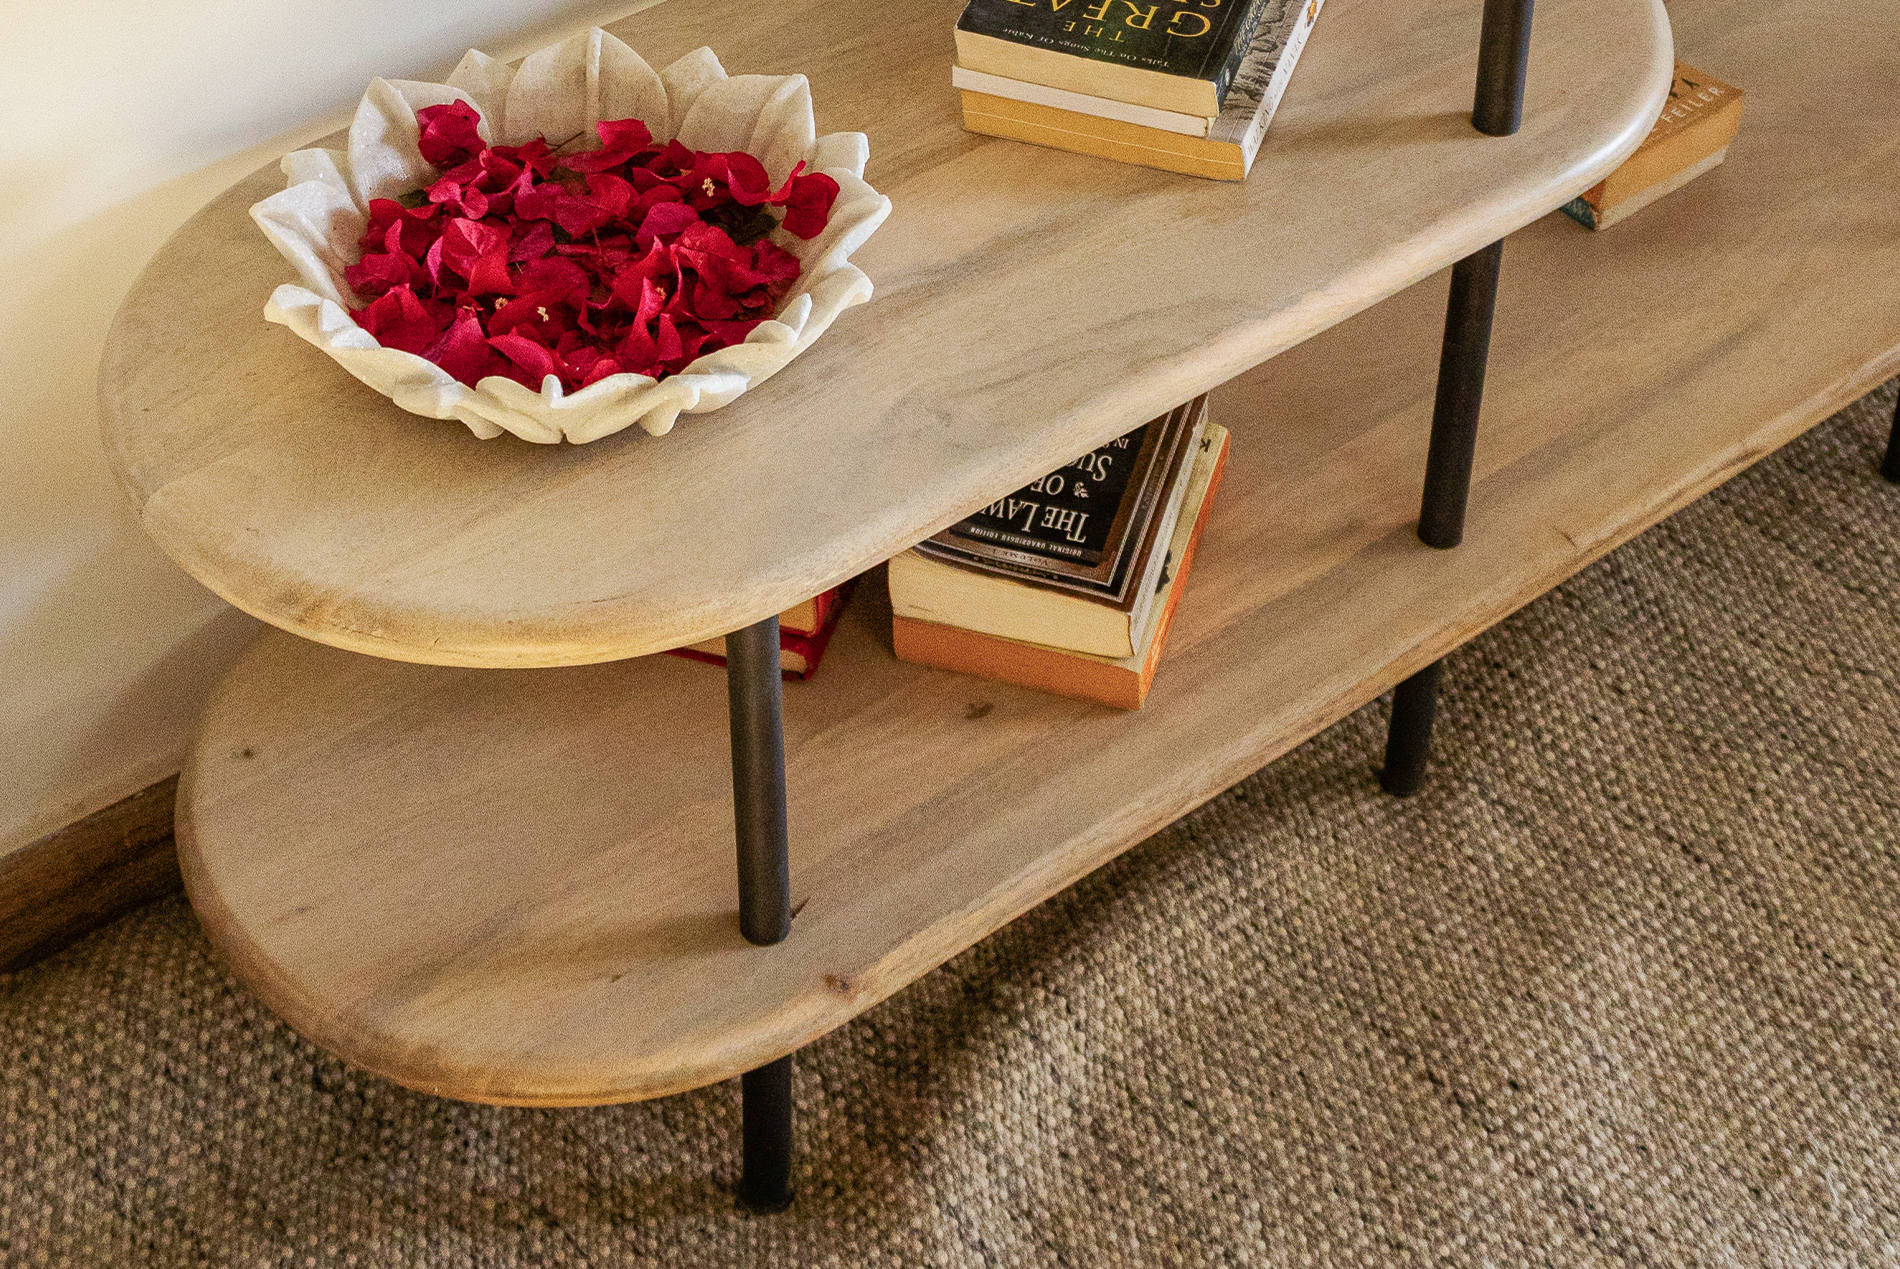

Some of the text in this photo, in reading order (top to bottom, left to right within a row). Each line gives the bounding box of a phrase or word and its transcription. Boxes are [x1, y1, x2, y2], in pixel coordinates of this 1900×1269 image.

[1063, 20, 1125, 43] THE
[1002, 28, 1170, 68] Talks On The Songs Of Kabir
[1041, 506, 1090, 543] THE
[1001, 534, 1046, 550] UNABRIDGED
[1050, 544, 1082, 557] ORIGINAL
